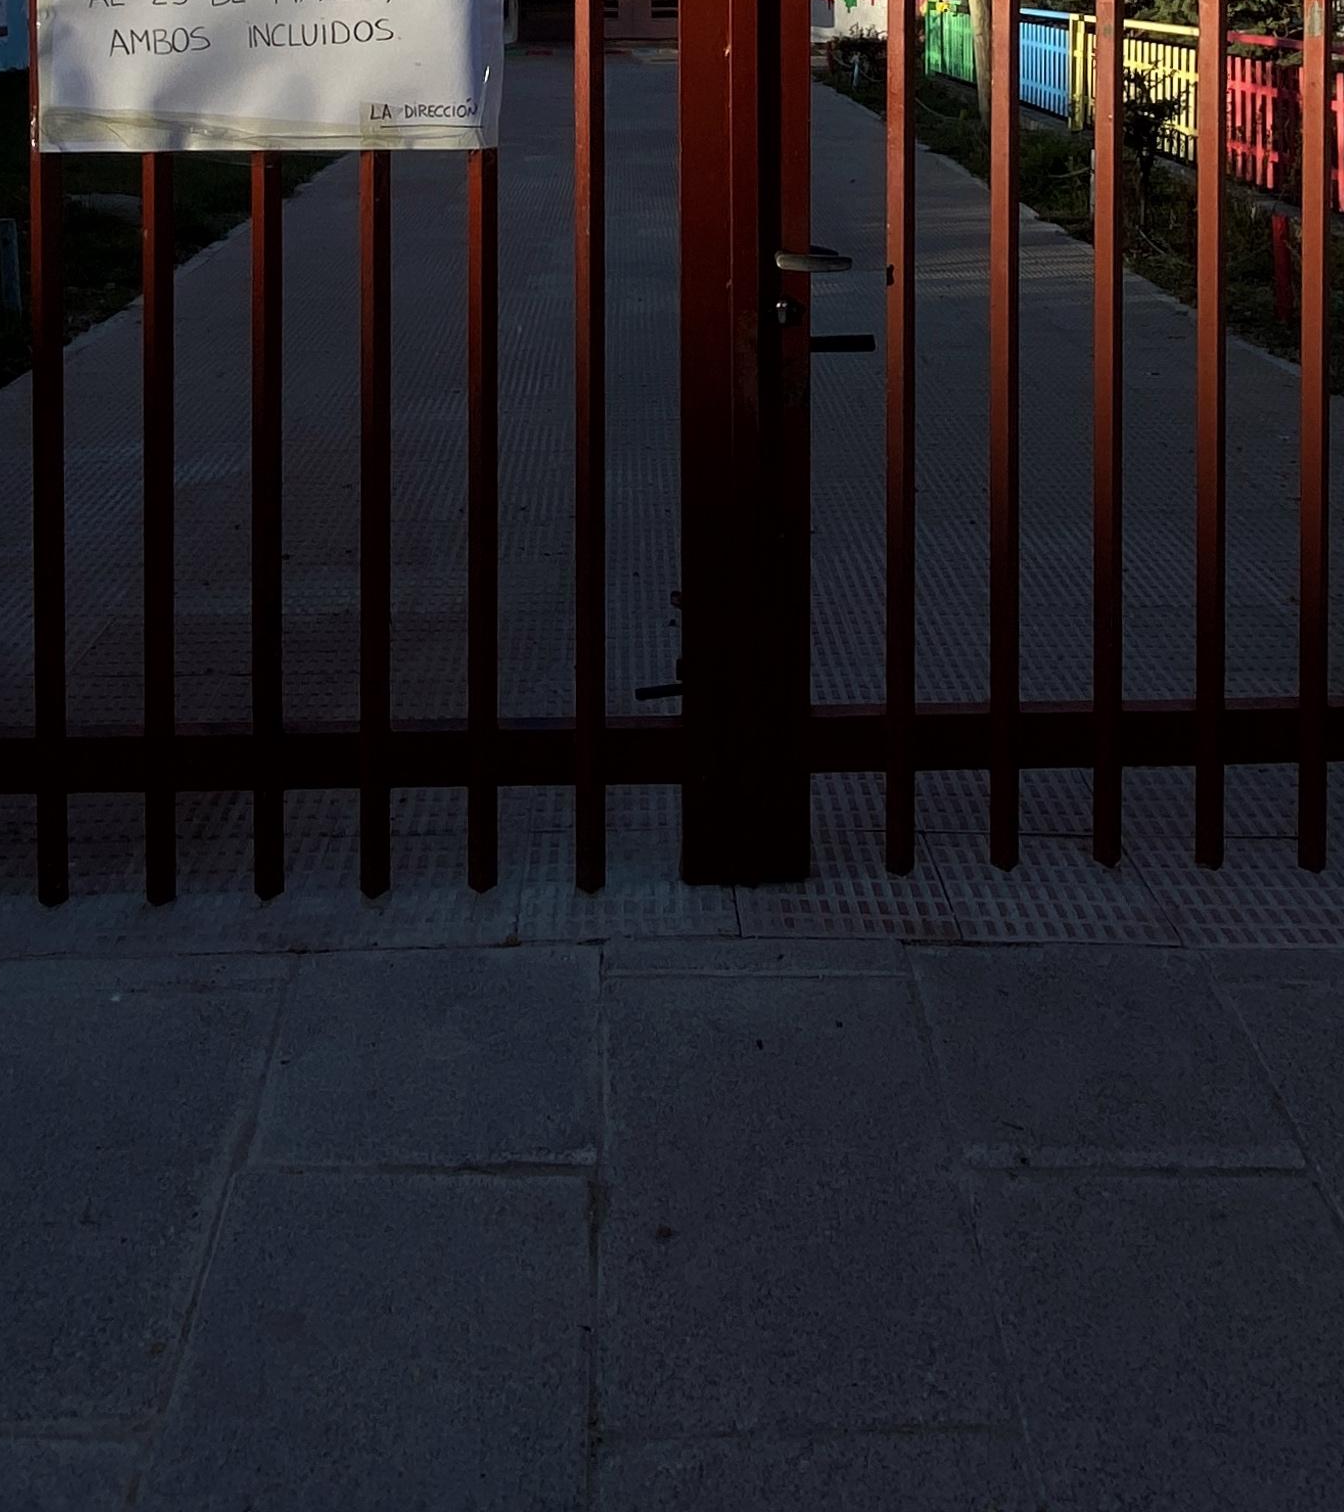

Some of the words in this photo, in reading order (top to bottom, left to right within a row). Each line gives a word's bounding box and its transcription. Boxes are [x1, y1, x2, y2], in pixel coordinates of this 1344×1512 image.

[109, 25, 211, 57] AMBOS
[369, 102, 393, 121] LA
[403, 98, 478, 120] DIRECCIÓN
